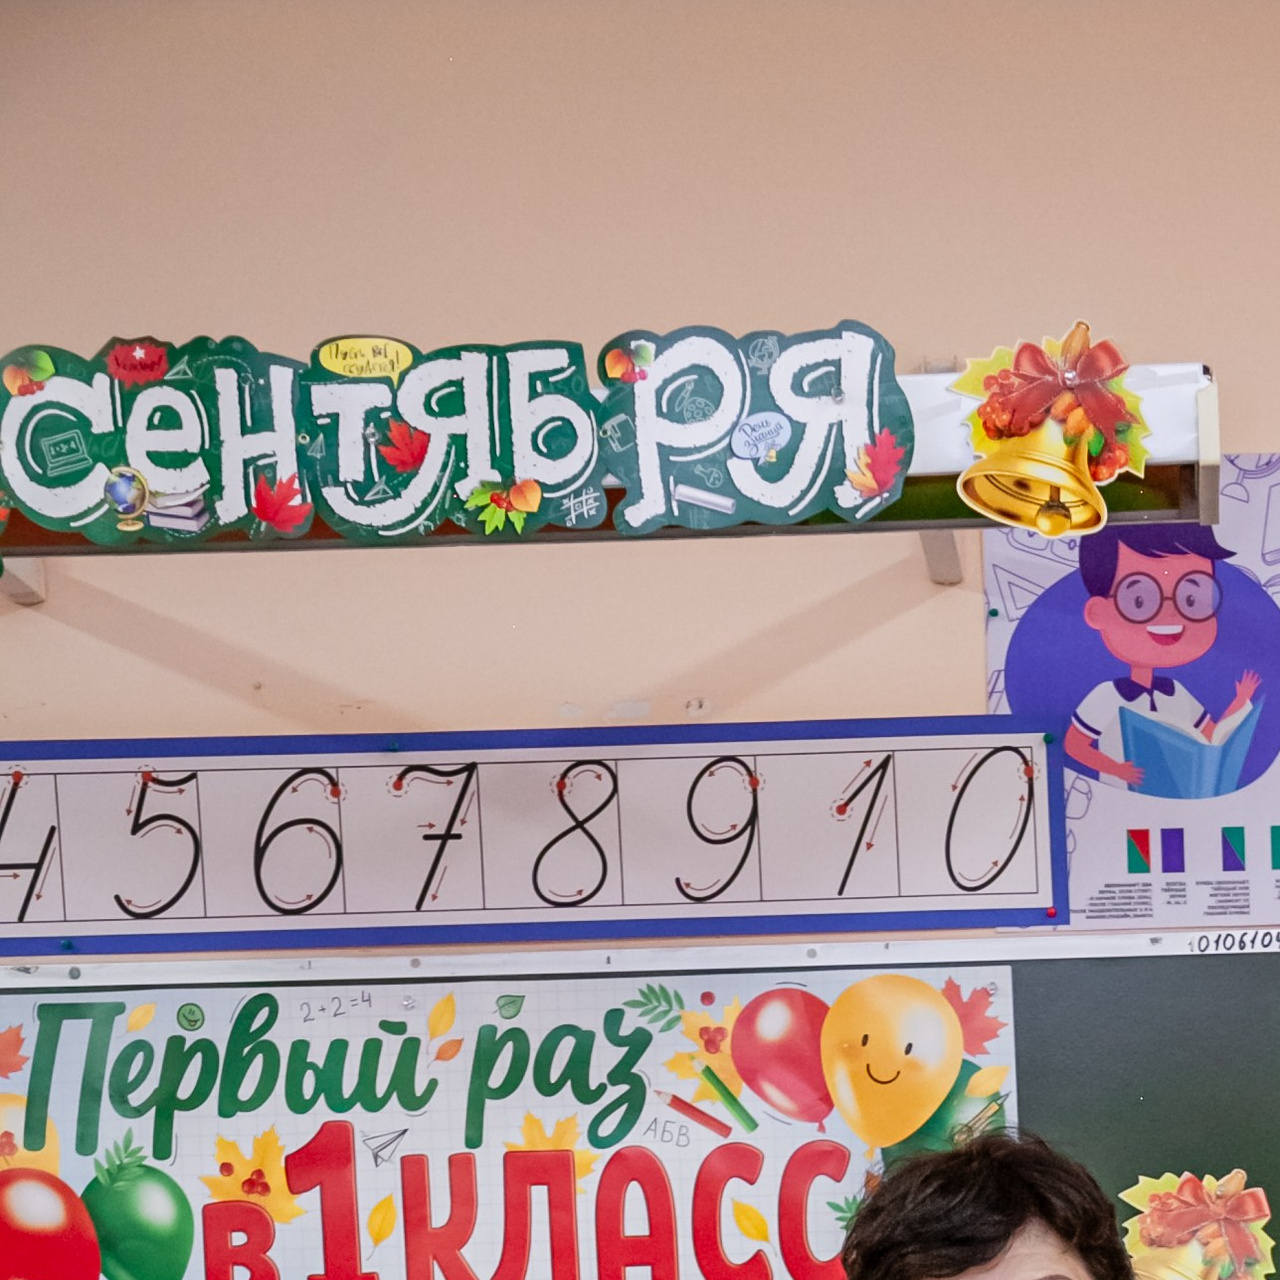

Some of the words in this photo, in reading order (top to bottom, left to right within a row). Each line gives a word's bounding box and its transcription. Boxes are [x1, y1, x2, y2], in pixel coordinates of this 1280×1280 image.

[114, 771, 199, 919] 5
[255, 769, 343, 916] 6
[396, 762, 478, 911] 7
[532, 761, 618, 907] 8
[675, 757, 758, 903] 9
[23, 993, 440, 1162] Первый
[465, 1008, 653, 1150] раз
[643, 1117, 692, 1148] АБВ
